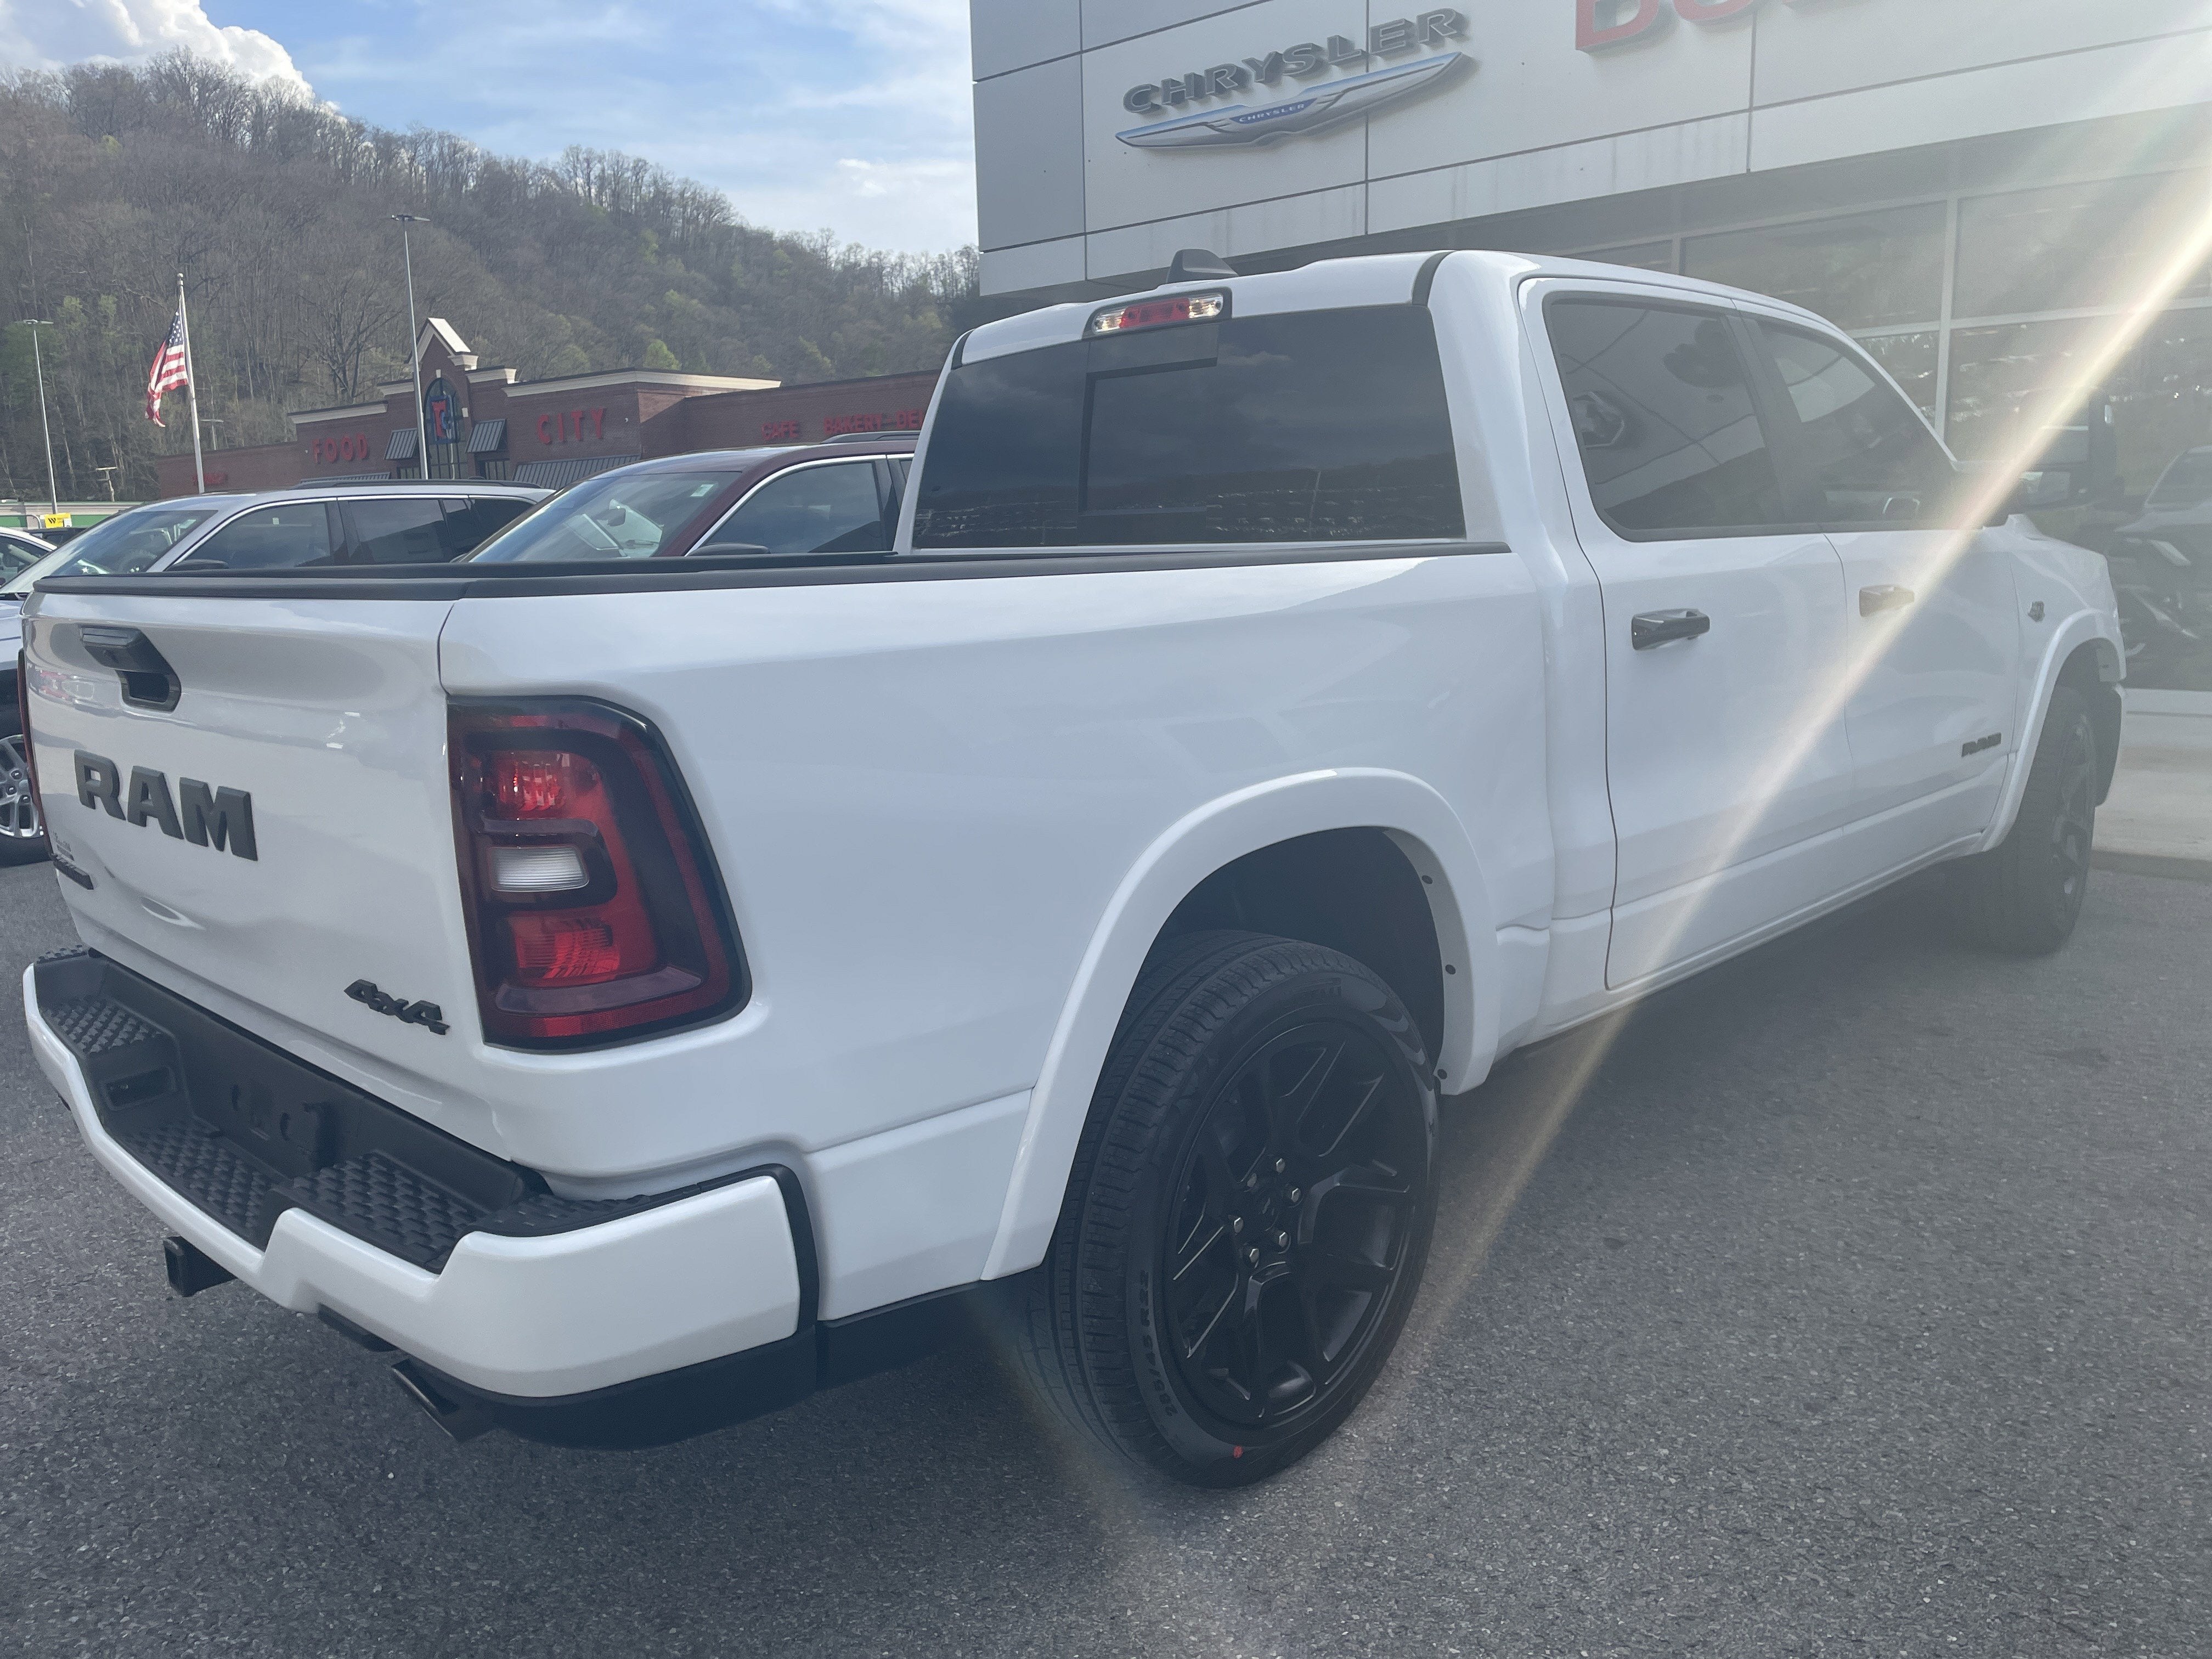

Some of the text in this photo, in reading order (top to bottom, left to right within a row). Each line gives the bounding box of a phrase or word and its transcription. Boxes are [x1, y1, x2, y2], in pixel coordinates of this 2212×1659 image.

[1122, 8, 1466, 113] CHRYSLER
[1239, 104, 1305, 122] CHRYSLER
[312, 407, 603, 464] FOOD CITY
[761, 420, 799, 441] CAFE
[74, 749, 258, 861] RAM
